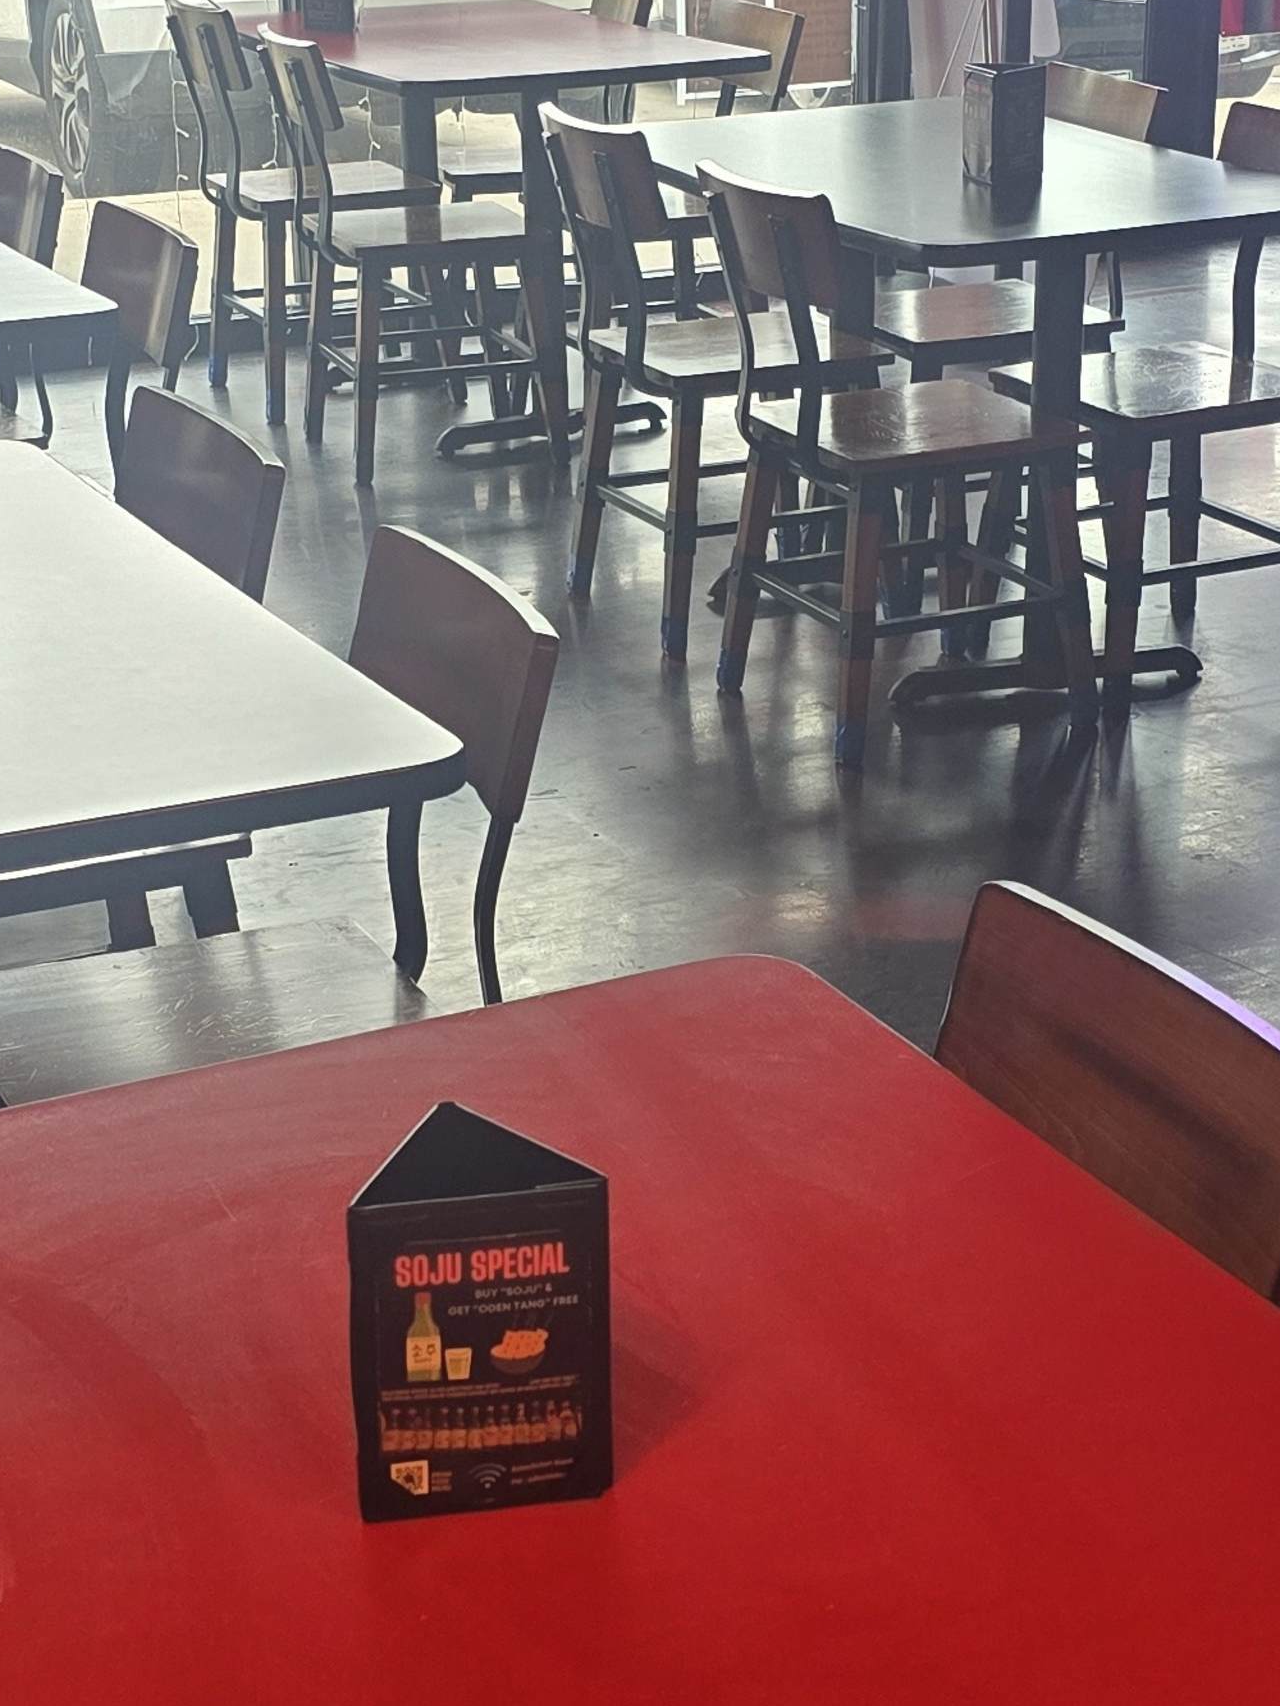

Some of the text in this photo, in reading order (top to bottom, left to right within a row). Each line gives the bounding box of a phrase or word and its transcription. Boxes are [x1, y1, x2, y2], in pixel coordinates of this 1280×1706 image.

[395, 1242, 570, 1287] SOJU SPECIAL
[475, 1288, 498, 1300] BUY
[448, 1304, 470, 1315] GET
[553, 1295, 579, 1306] FREE
